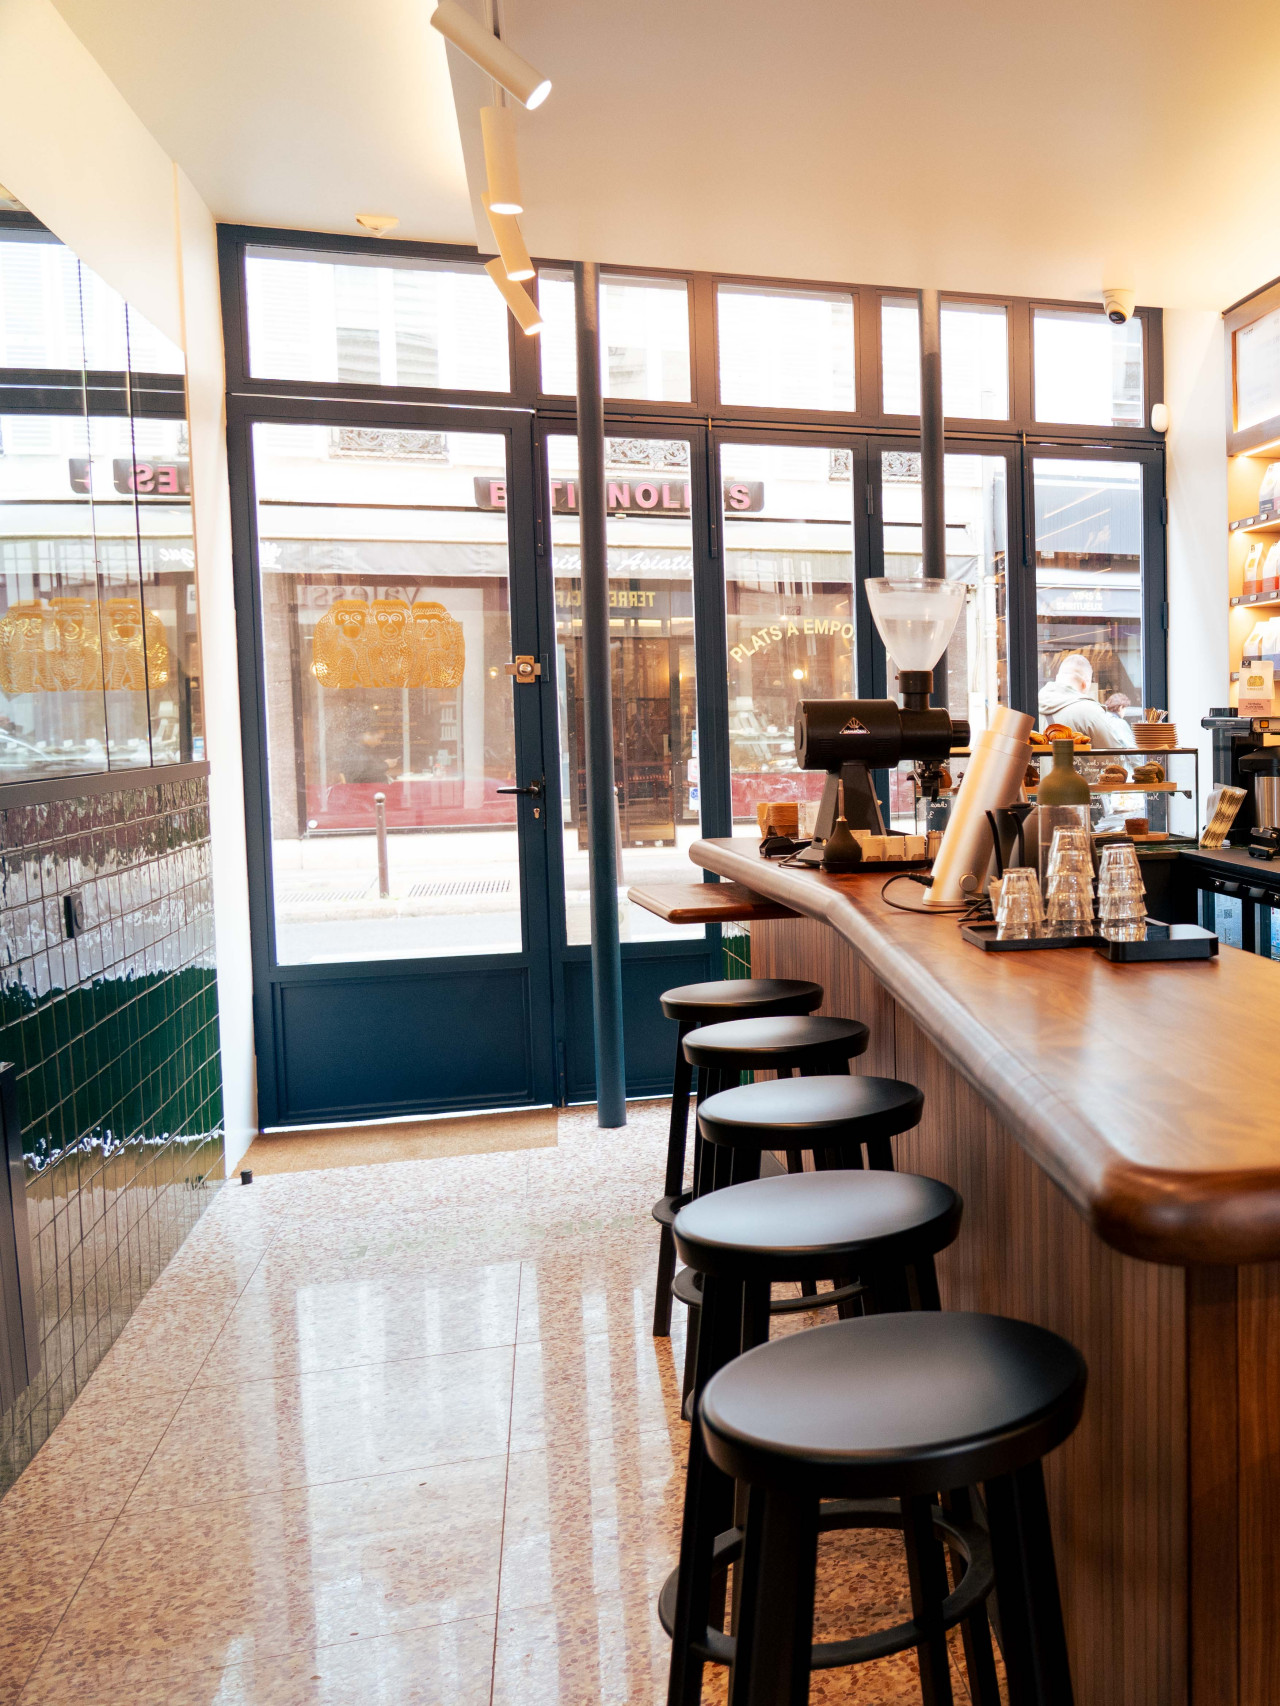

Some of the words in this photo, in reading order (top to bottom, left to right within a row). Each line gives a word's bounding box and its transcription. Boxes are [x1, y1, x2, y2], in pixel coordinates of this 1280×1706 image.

[490, 481, 751, 510] BTINOLS
[616, 551, 692, 572] Asiati
[730, 625, 783, 664] PLATS
[787, 621, 800, 638] A
[803, 618, 856, 641] EMPO
